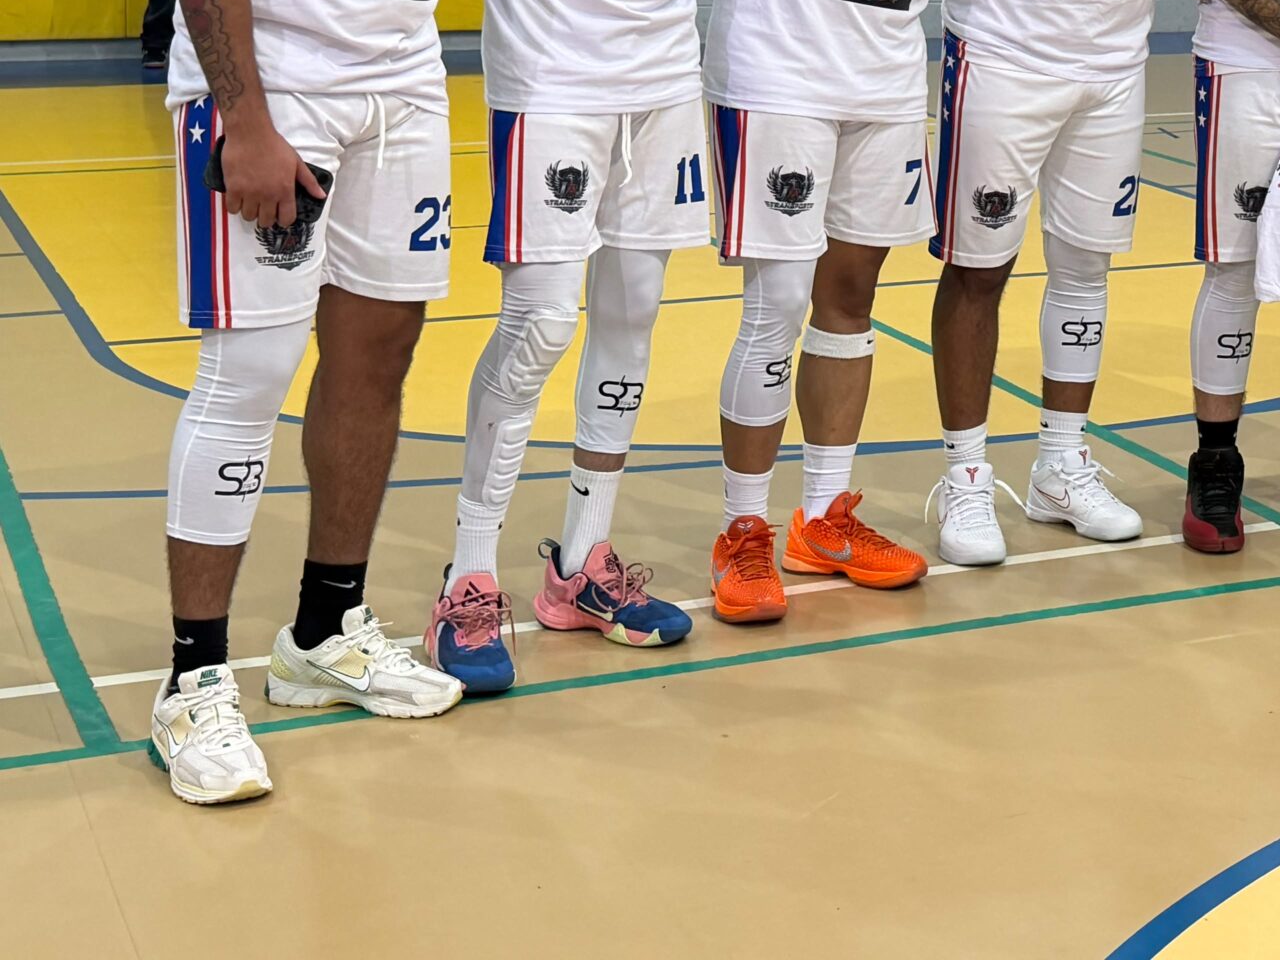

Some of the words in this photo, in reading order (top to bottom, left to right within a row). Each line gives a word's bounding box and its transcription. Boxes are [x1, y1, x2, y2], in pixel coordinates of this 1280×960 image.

[674, 153, 705, 205] 11
[904, 158, 922, 205] 7
[200, 668, 219, 680] NIKE
